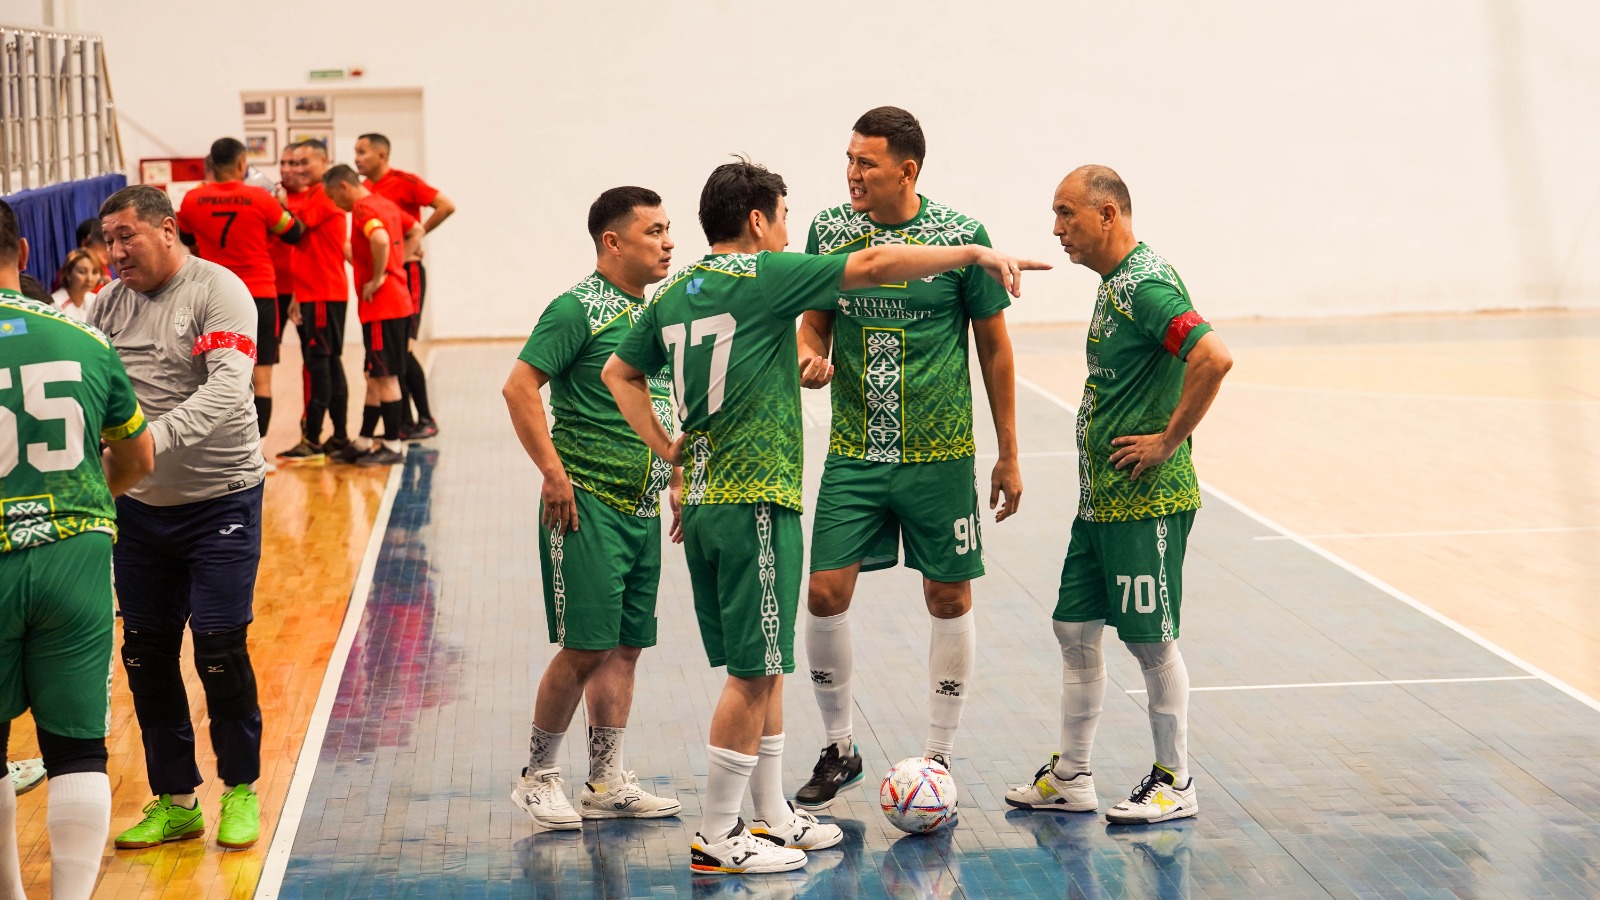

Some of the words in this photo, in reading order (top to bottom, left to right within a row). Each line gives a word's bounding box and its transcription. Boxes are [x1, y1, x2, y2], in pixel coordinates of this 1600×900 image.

[212, 211, 238, 248] 7
[853, 297, 907, 310] ATYRAU
[854, 307, 935, 320] UNIVERSITY
[661, 312, 737, 422] 77
[953, 513, 978, 555] 90
[1116, 575, 1156, 613] 70
[935, 689, 960, 697] KELME
